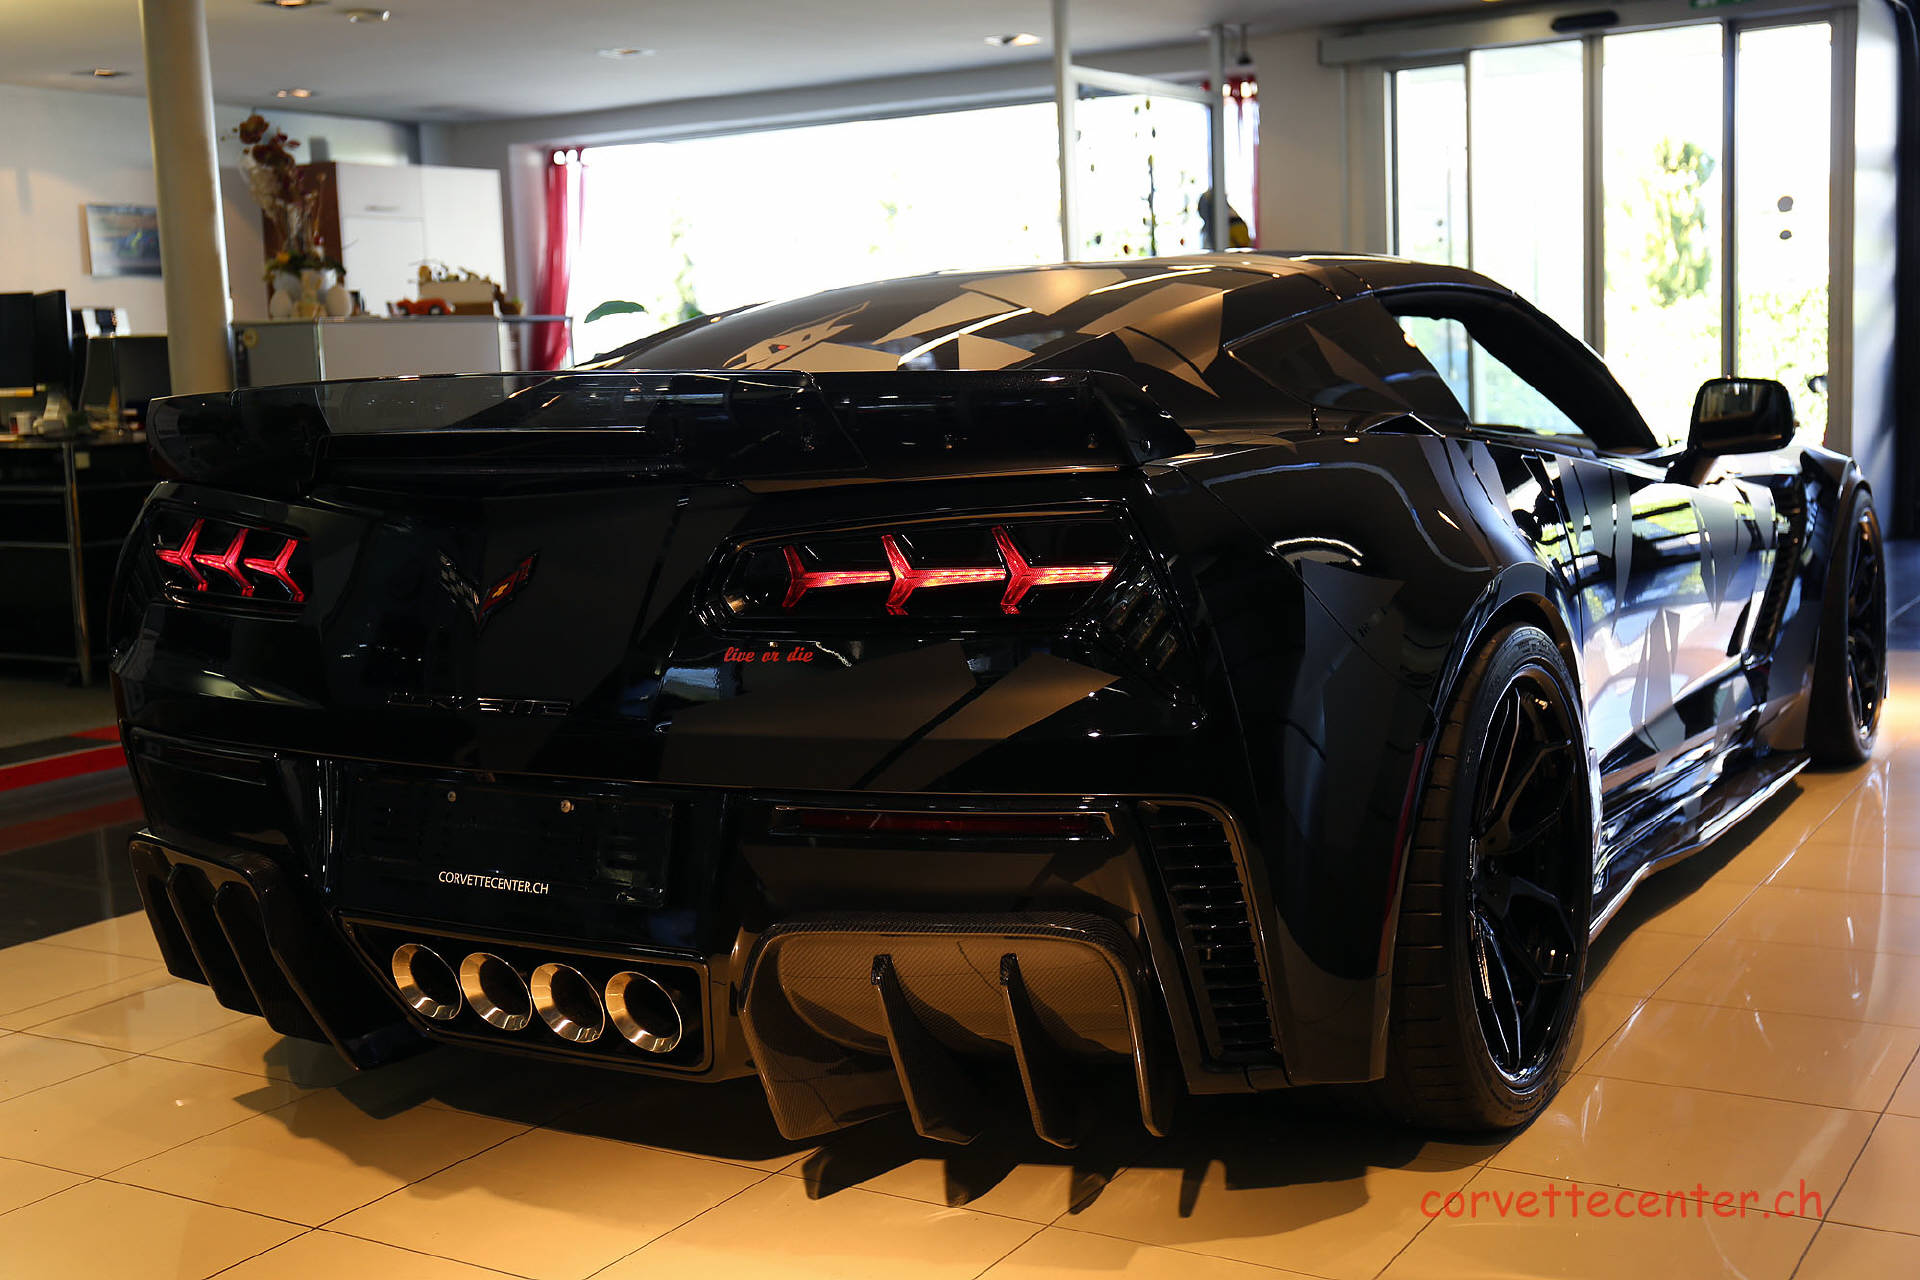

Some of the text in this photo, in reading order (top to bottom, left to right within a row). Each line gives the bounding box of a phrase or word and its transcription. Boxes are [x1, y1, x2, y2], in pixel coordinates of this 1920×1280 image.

[723, 646, 815, 663] live or die
[438, 871, 549, 895] CORVETTECENTER.CH
